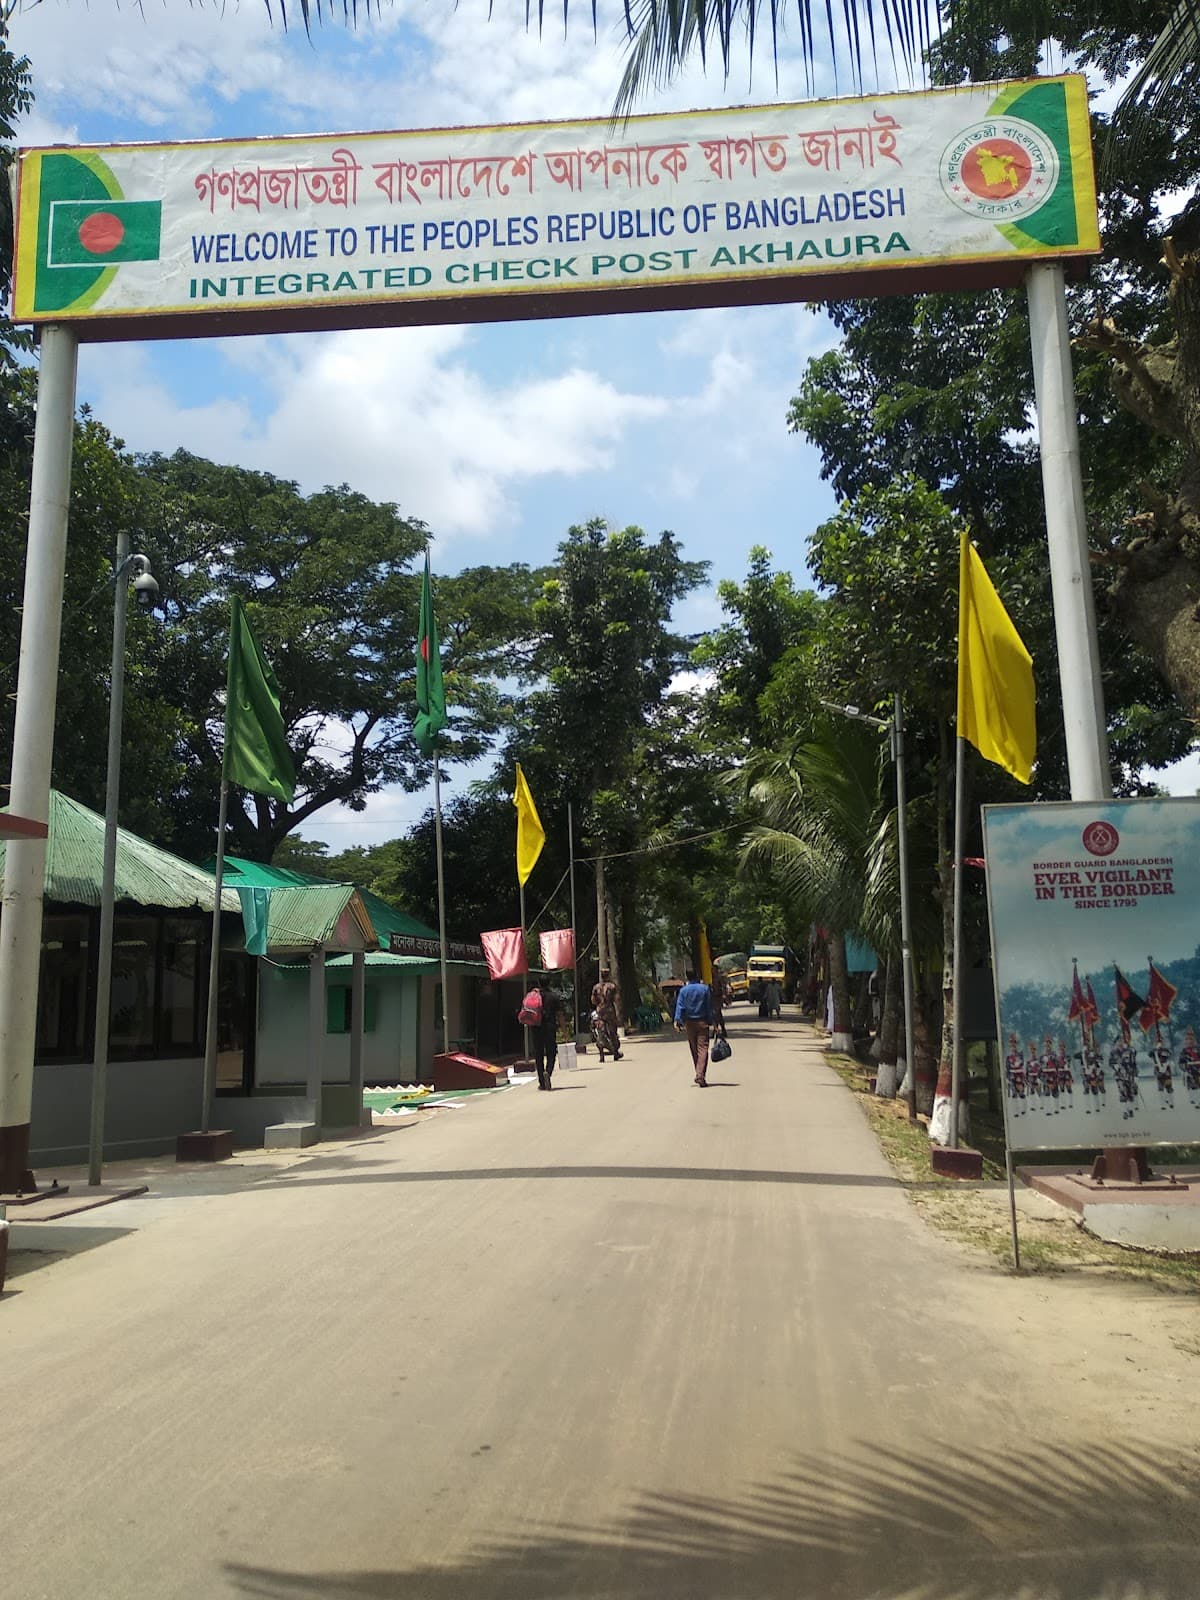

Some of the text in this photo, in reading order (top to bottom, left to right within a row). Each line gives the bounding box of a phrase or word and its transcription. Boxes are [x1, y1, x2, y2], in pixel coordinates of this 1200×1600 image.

[194, 110, 903, 214] গণপ্রজাতন্ত্রী বাংলাদেশে আপনাকে স্বাগত জানাই
[976, 200, 1022, 215] সরকার
[192, 187, 906, 264] WELCOME TO THE PEOPLES REPUBLIC OF BANGLADESH
[189, 231, 911, 299] INTEGRATED CHECK POST AKHAURA
[1033, 857, 1173, 870] BORDER GUARD BANGLADESH
[1034, 868, 1174, 886] EVER VIGILANT
[1035, 882, 1175, 900] IN THE BORDER
[1075, 899, 1137, 909] SINCE 1795
